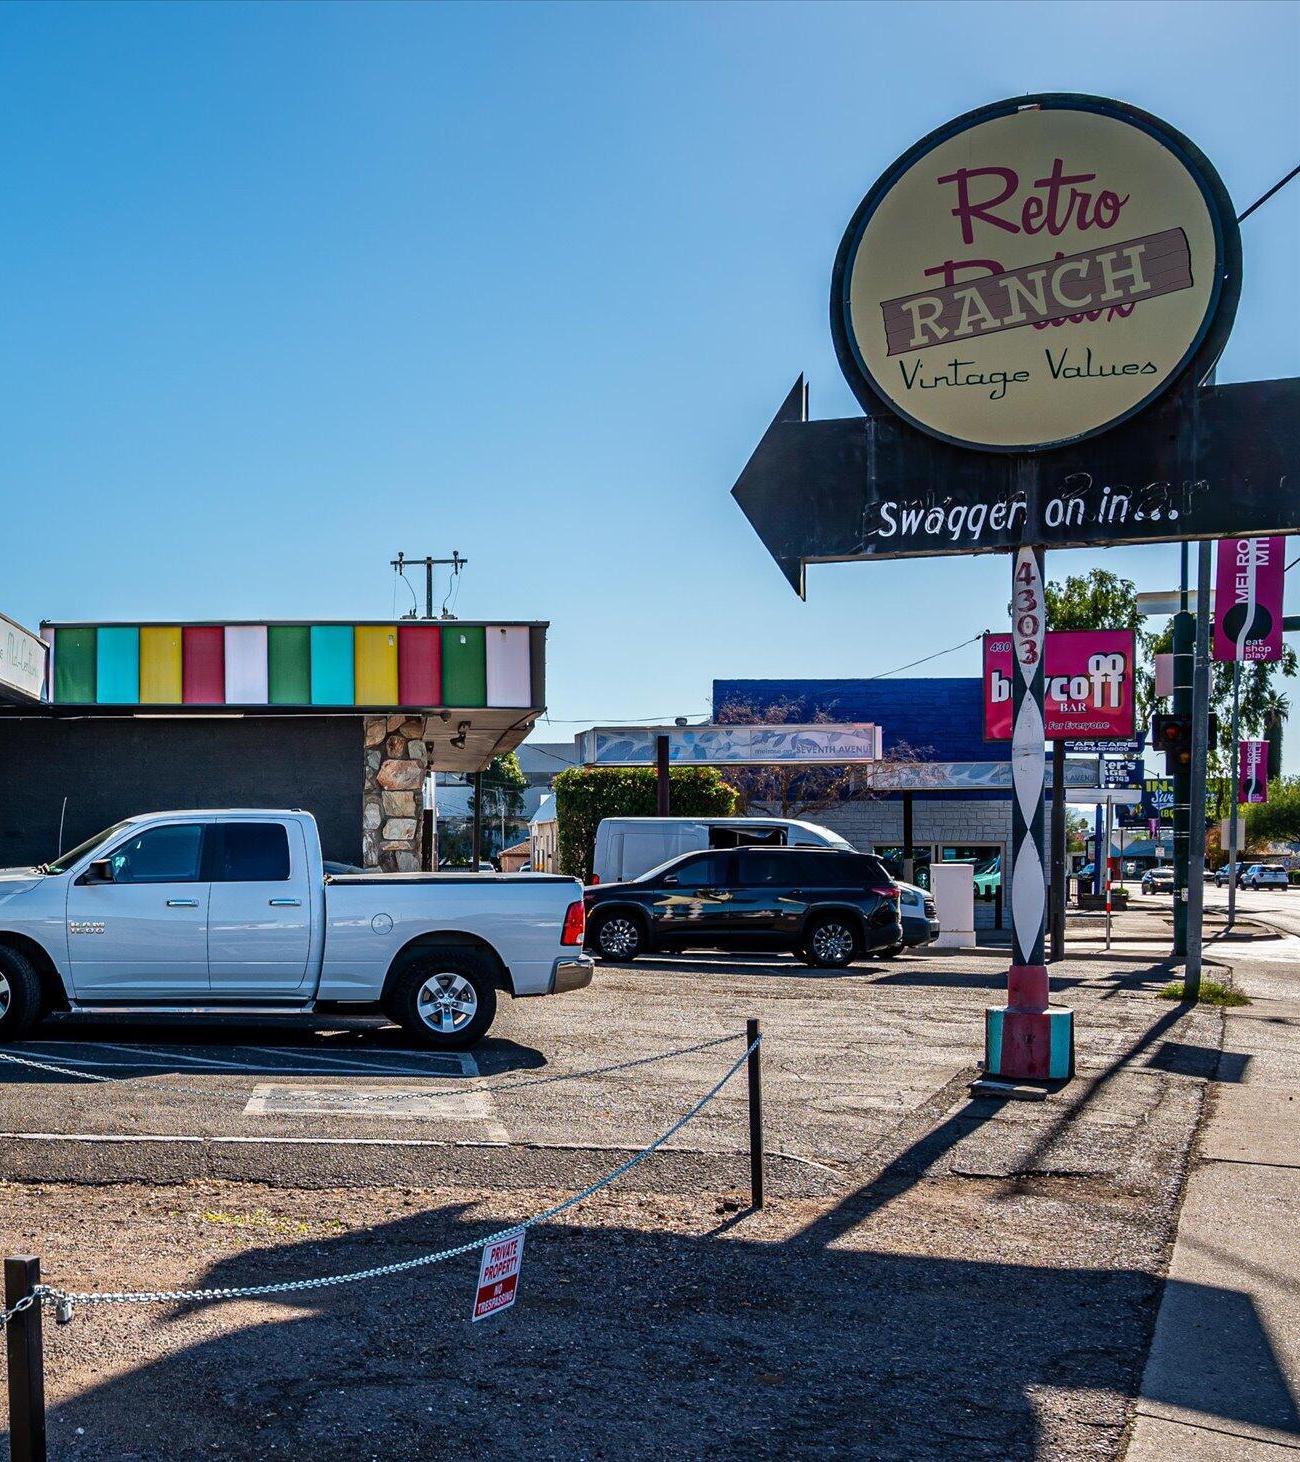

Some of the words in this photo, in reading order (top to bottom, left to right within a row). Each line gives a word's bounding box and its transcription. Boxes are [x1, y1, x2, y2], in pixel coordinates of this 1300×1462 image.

[937, 158, 1130, 244] Retro
[901, 244, 1151, 347] RANCH
[899, 358, 1030, 400] Vintage
[1045, 347, 1158, 380] Values
[878, 500, 1027, 541] Swagger
[1044, 498, 1086, 527] on
[1234, 538, 1250, 604] MELRO
[1015, 561, 1040, 665] 4303
[1245, 644, 1272, 654] shop
[1245, 652, 1268, 661] play
[1059, 703, 1087, 712] BAR
[1064, 721, 1110, 732] Everyone
[796, 745, 836, 755] SEVENTH
[490, 1240, 518, 1262] PRIVATE
[483, 1256, 518, 1282] PROPERTY
